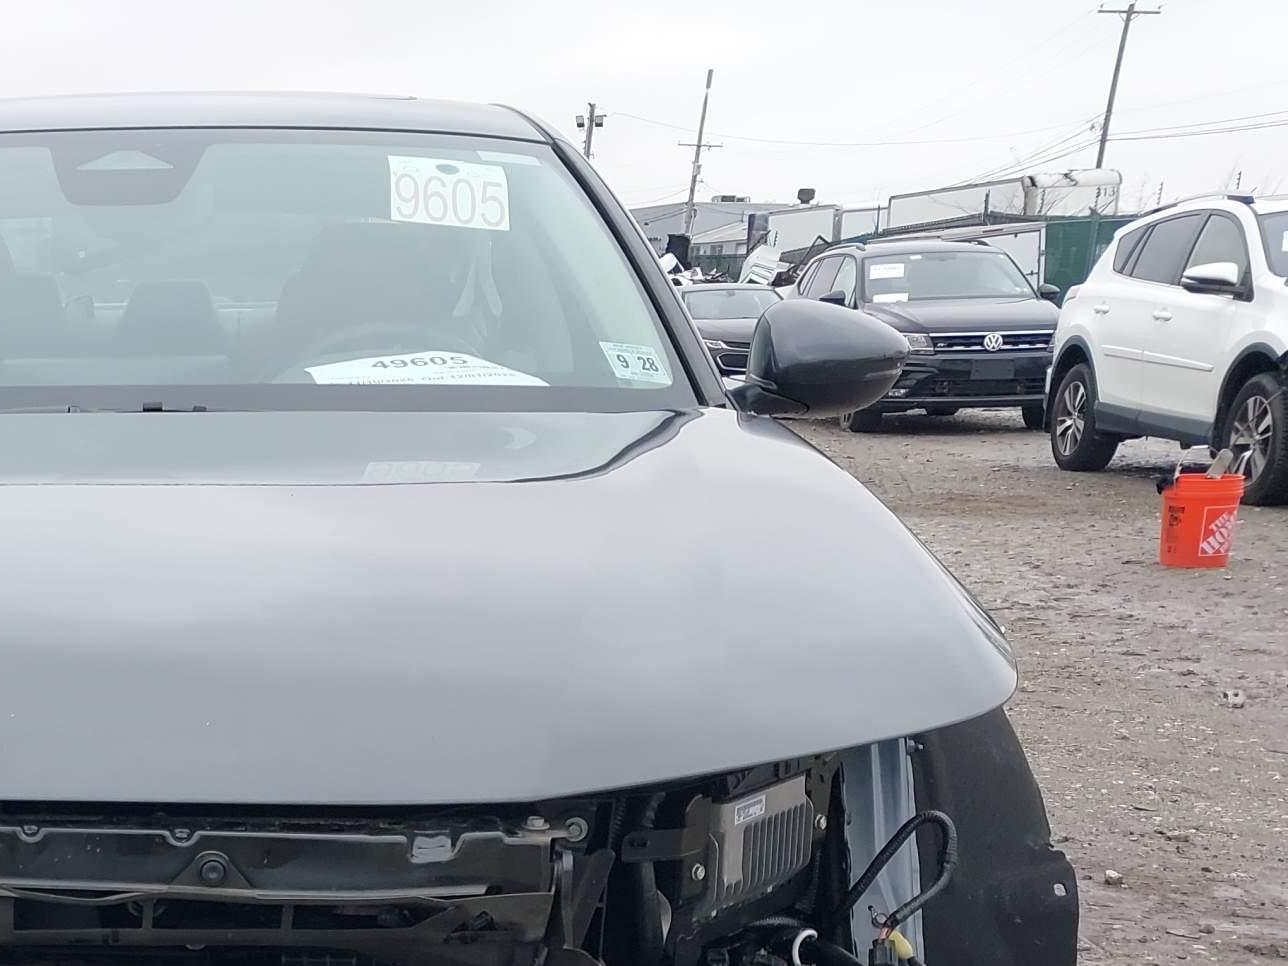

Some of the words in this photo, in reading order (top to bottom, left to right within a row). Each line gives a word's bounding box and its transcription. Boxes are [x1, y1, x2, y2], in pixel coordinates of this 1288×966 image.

[395, 173, 506, 227] 9605
[371, 355, 469, 369] 49605
[616, 354, 630, 369] 9
[637, 356, 660, 373] 28
